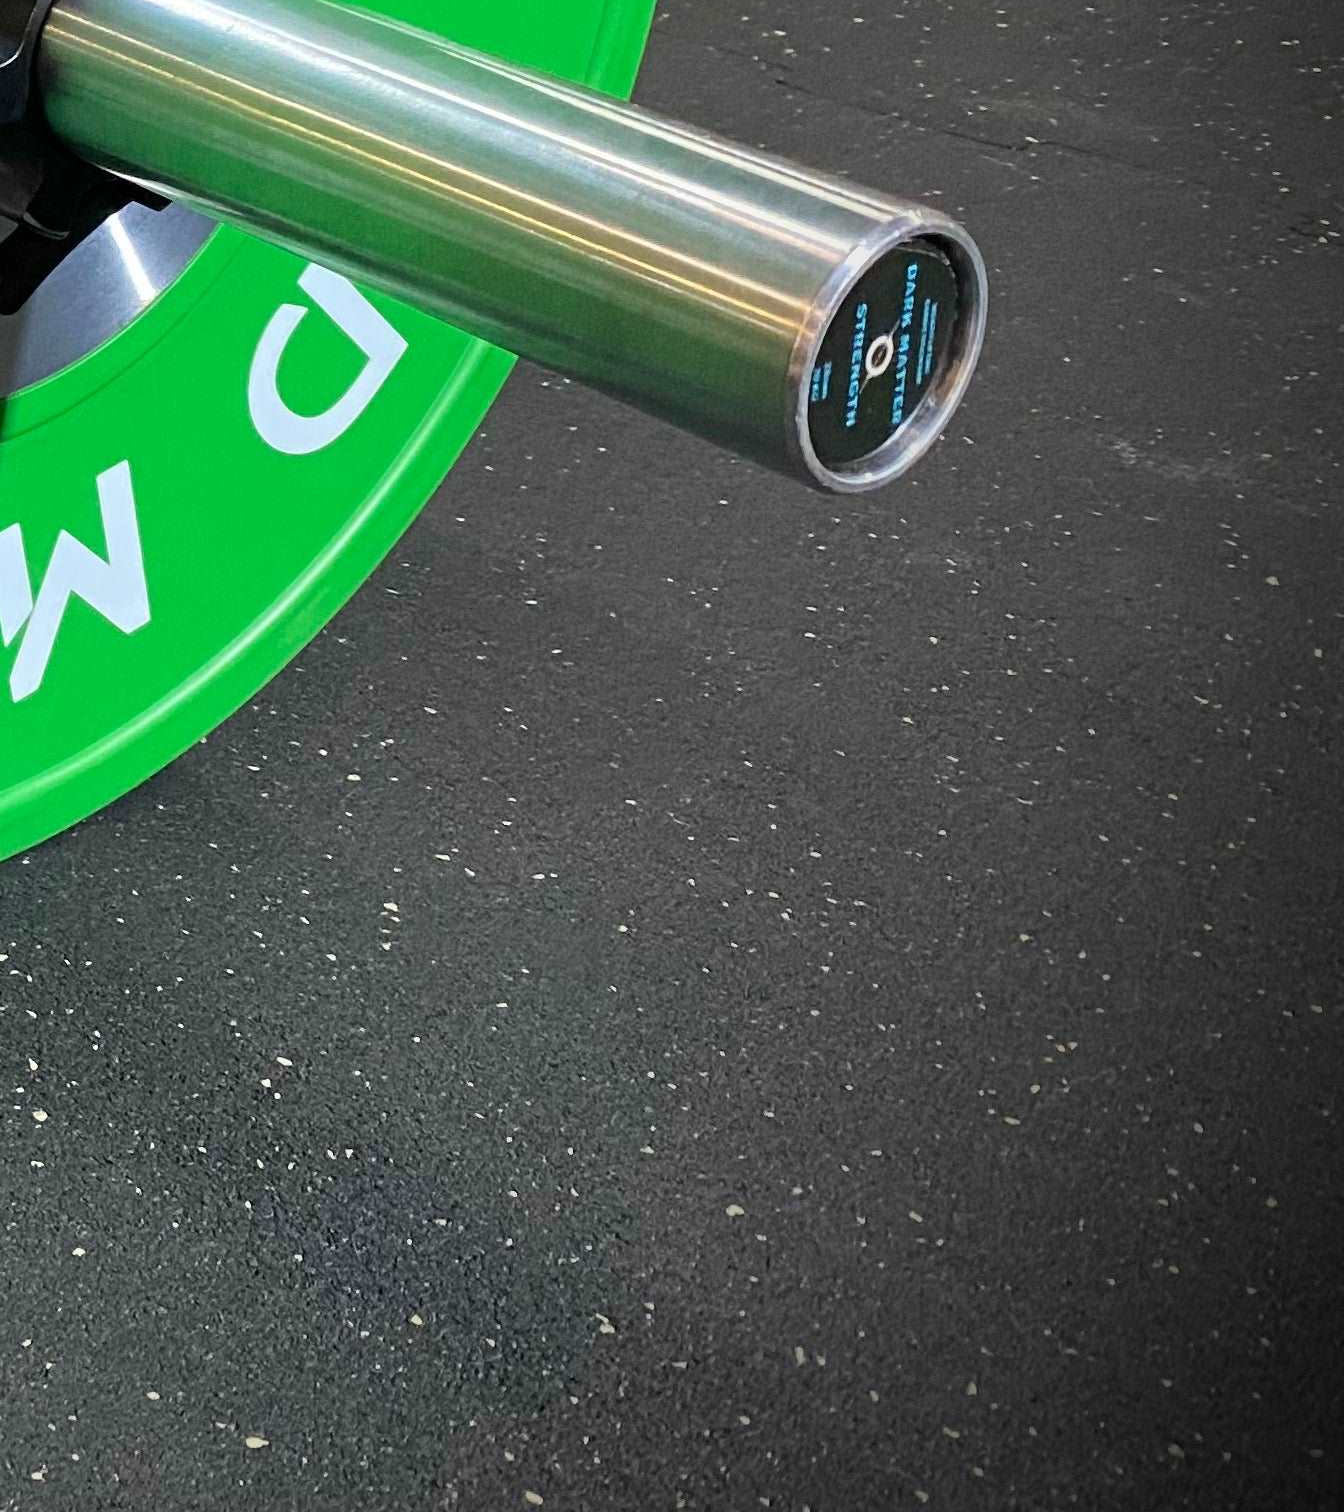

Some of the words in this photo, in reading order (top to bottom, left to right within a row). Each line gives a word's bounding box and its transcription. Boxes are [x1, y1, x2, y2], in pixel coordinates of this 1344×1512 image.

[900, 263, 918, 329] DARK
[844, 302, 868, 428] STRENGTH
[891, 333, 912, 425] MATTER
